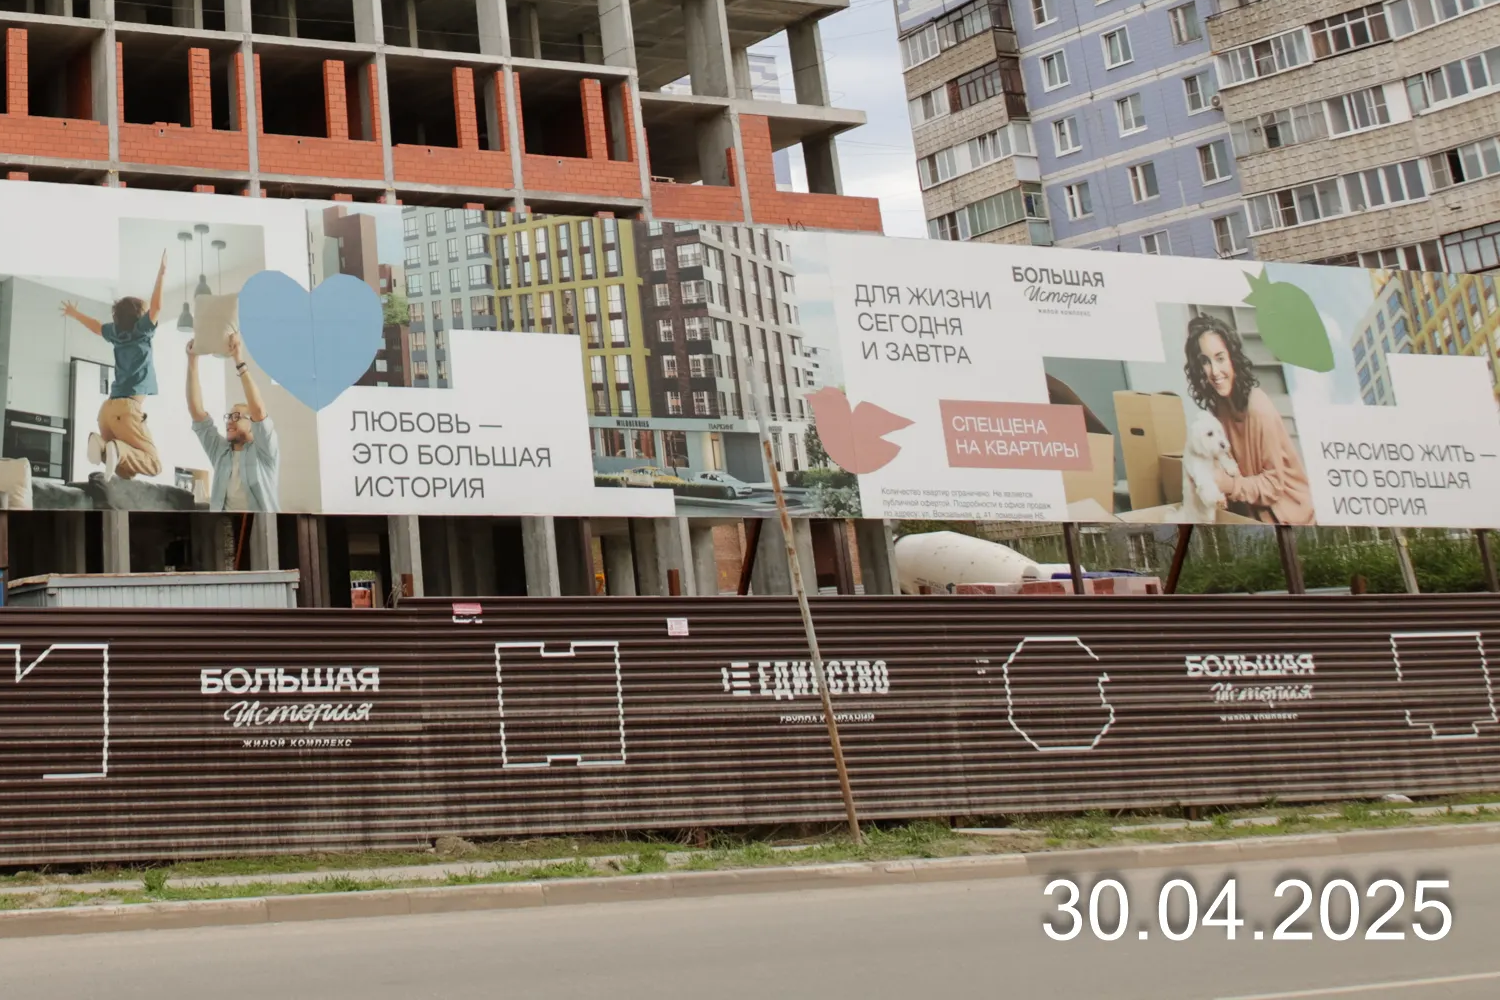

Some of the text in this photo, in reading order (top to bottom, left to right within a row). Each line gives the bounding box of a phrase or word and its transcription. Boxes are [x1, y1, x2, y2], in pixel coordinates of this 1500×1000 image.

[1011, 266, 1105, 288] БОЛЬШАЯ
[855, 284, 992, 309] ДЛЯ ЖИЗНИ
[1024, 285, 1097, 309] История
[858, 312, 963, 339] СЕГОДНЯ
[862, 341, 972, 364] И ЗАВТРА
[350, 411, 471, 433] ЛЮБОВЬ
[952, 416, 1048, 436] СПЕЦЦЕНА
[352, 443, 551, 467] ЭТО БОЛЬШАЯ
[956, 439, 1080, 458] НА КВАРТИРЫ
[1320, 442, 1414, 461] КРАСИВО
[1418, 444, 1475, 462] ЖИТЬ
[355, 475, 485, 499] ИСТОРИЯ
[1327, 469, 1471, 489] ЭТО БОЛЬШАЯ
[1332, 497, 1428, 516] ИСТОРИЯ
[1185, 653, 1315, 677] БОЛЬШАЯ
[200, 667, 380, 694] БОЛЬШАЯ
[223, 700, 373, 730] История
[819, 712, 875, 722] КМПАНИЙ
[242, 737, 352, 748] ЖИЛОЙ КОМПЛЕКС
